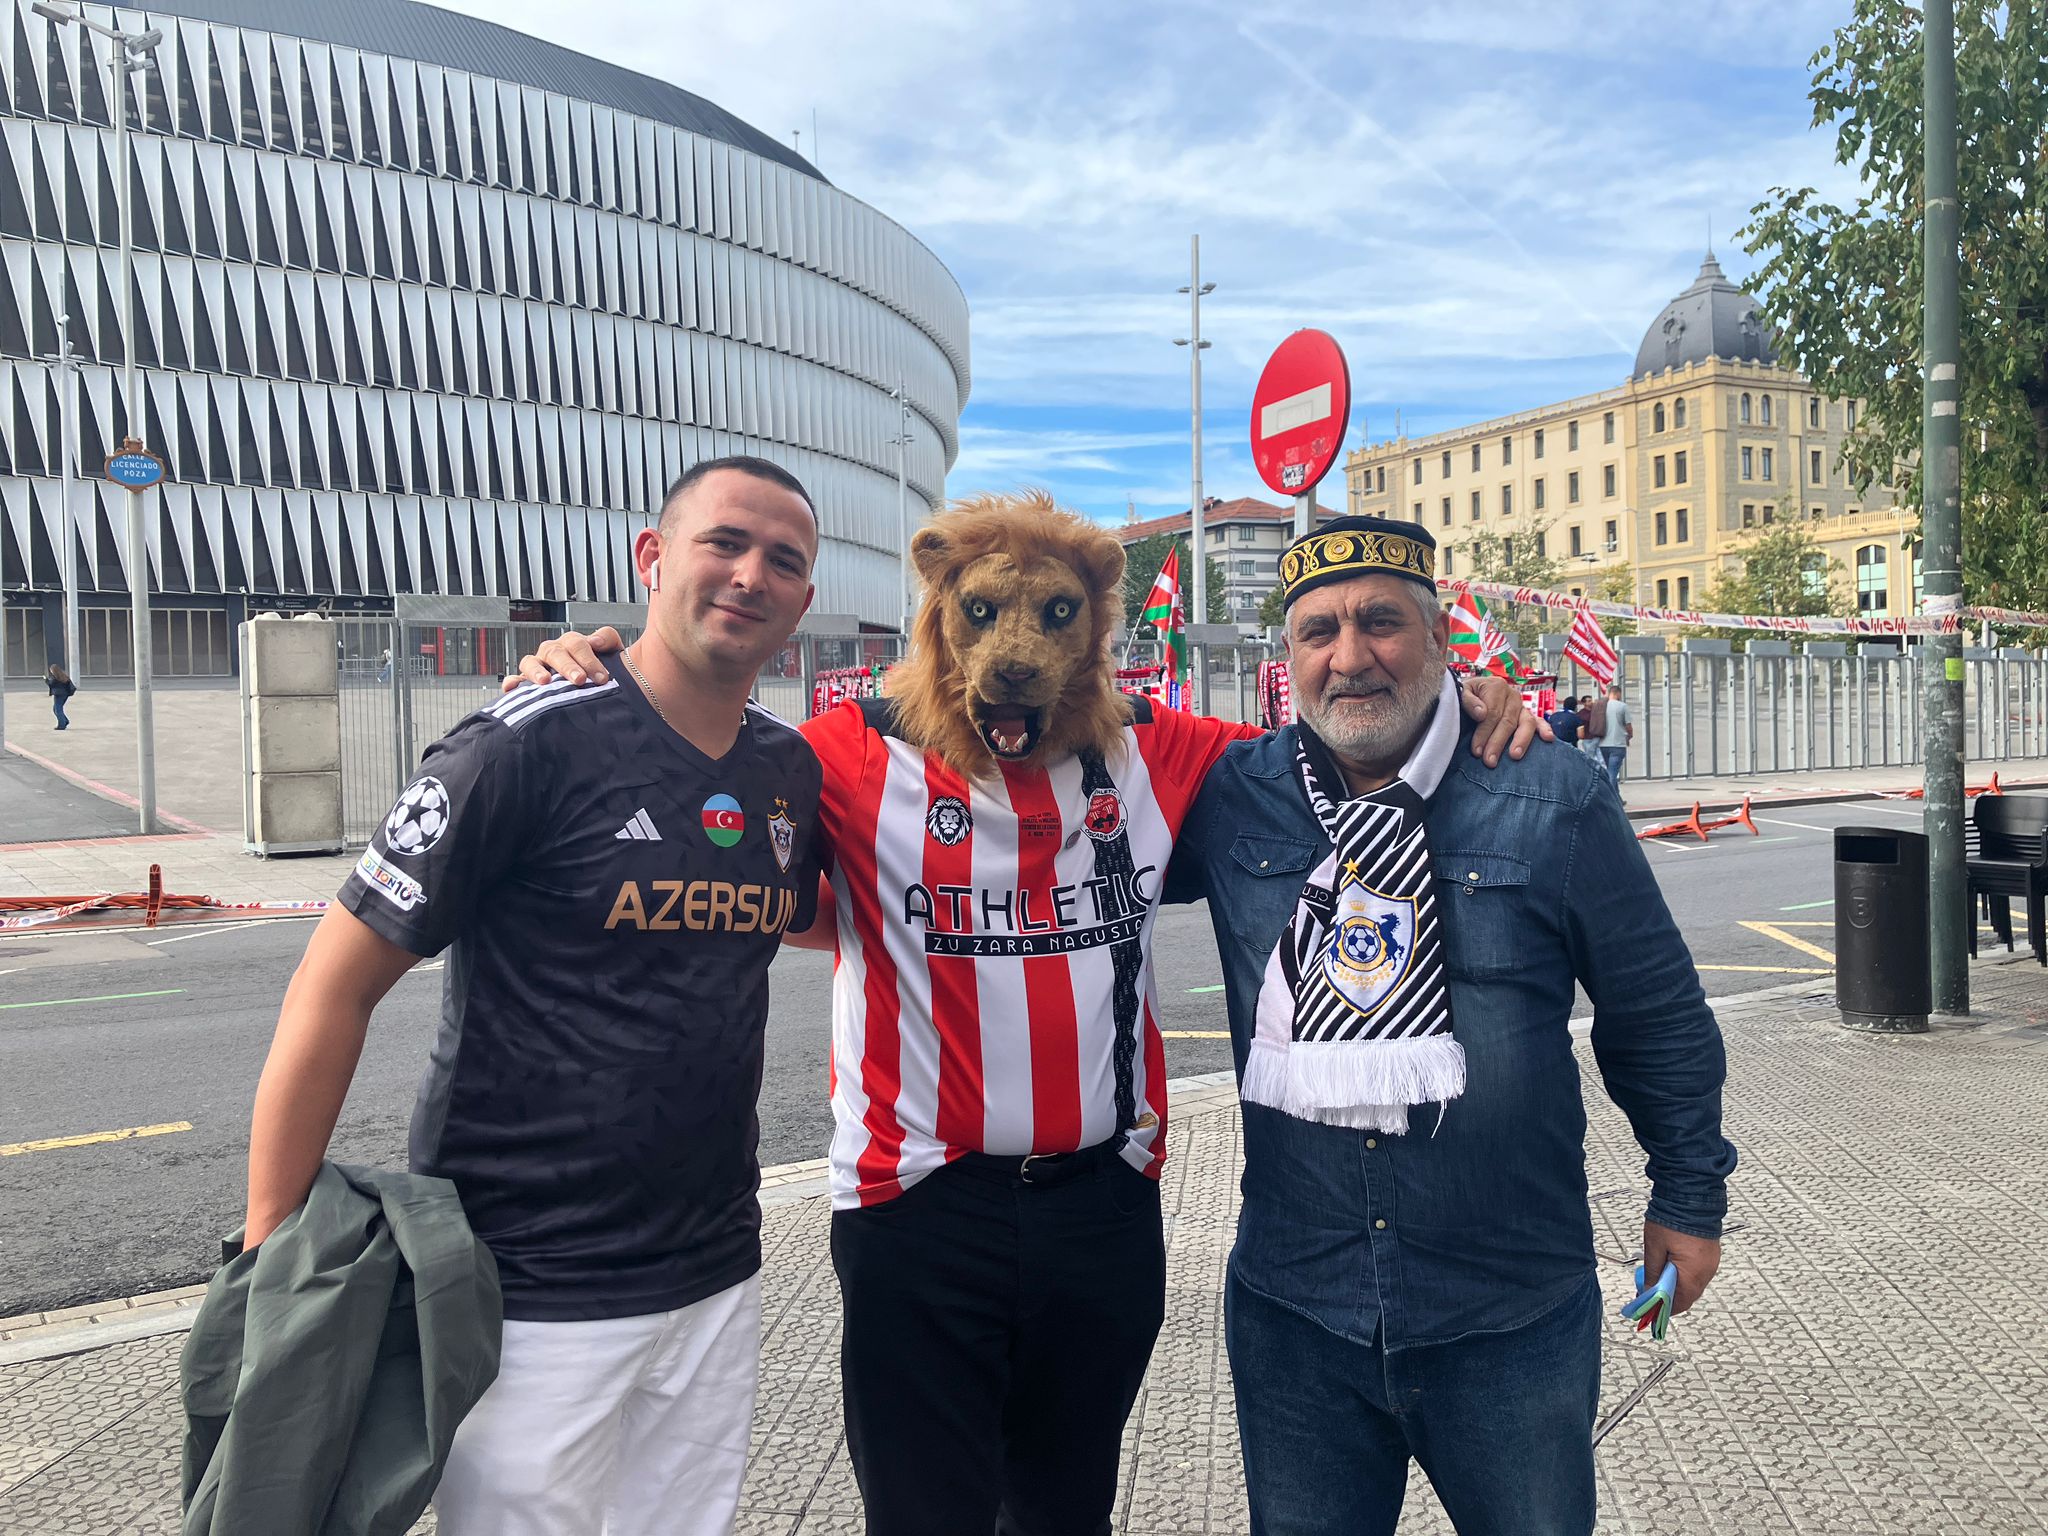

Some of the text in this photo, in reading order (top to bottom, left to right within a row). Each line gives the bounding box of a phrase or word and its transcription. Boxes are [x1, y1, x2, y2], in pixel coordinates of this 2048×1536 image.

[111, 461, 158, 469] LICENCIADO
[124, 470, 147, 478] POZA
[317, 597, 334, 610] 21
[603, 880, 798, 934] AZERSUN
[904, 864, 1156, 931] ATHLETIC
[933, 919, 1142, 952] ZU ZARA NAGUSIA
